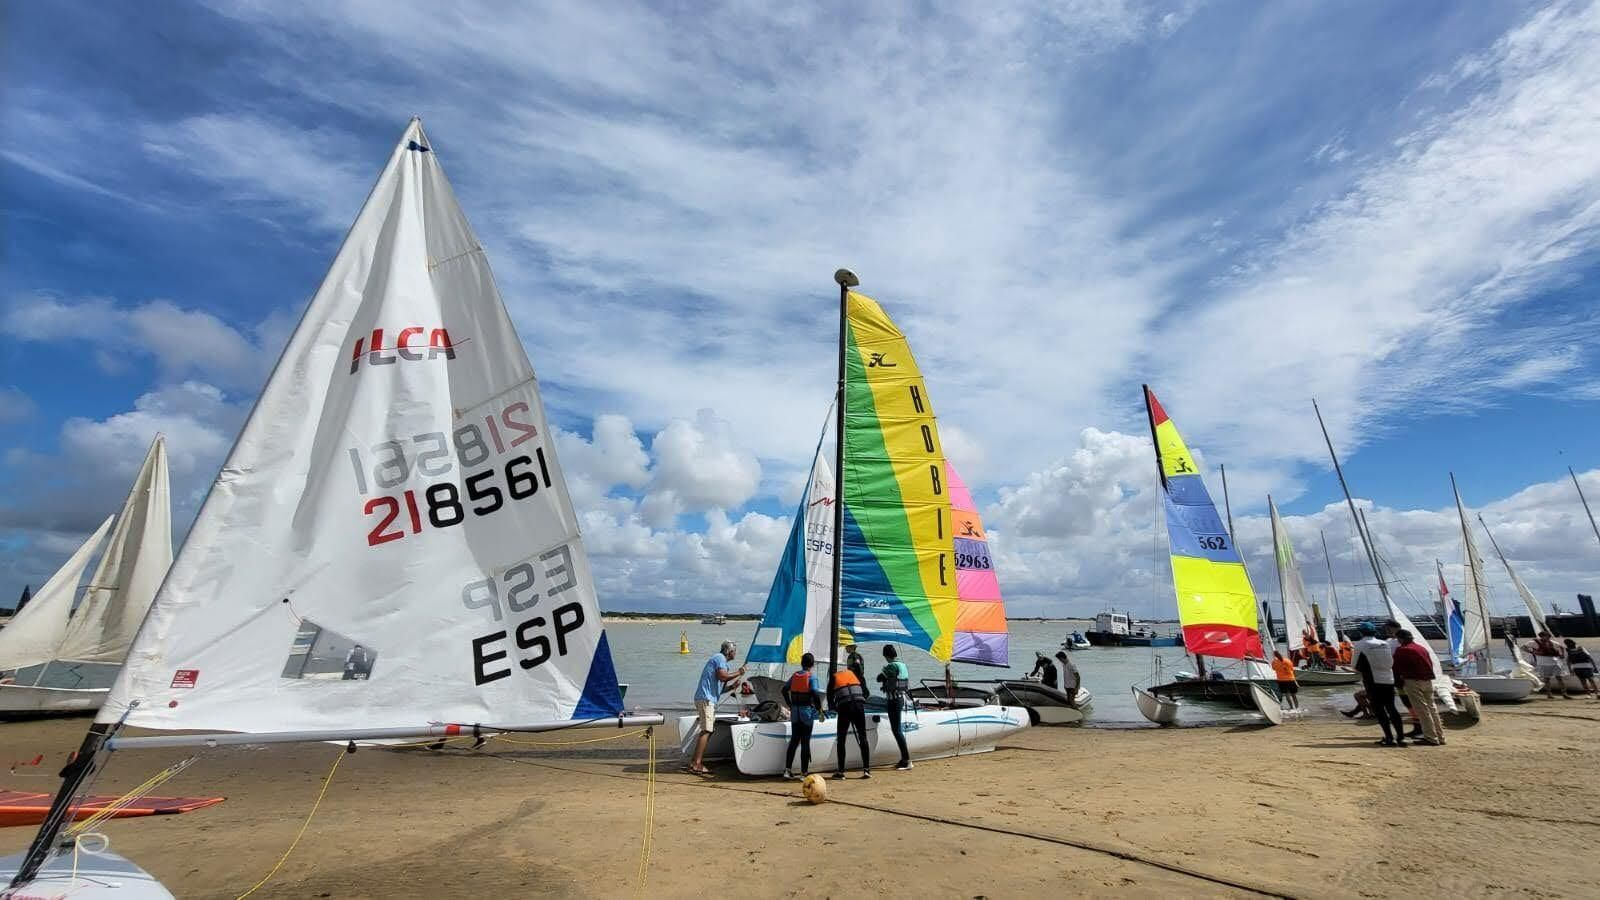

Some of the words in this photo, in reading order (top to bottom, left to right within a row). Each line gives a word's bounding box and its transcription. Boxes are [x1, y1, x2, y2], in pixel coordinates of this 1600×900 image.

[349, 327, 457, 375] ILCA
[364, 446, 552, 547] 218561
[909, 385, 947, 586] HOBIE
[1198, 535, 1228, 550] 562
[472, 602, 585, 686] ESP
